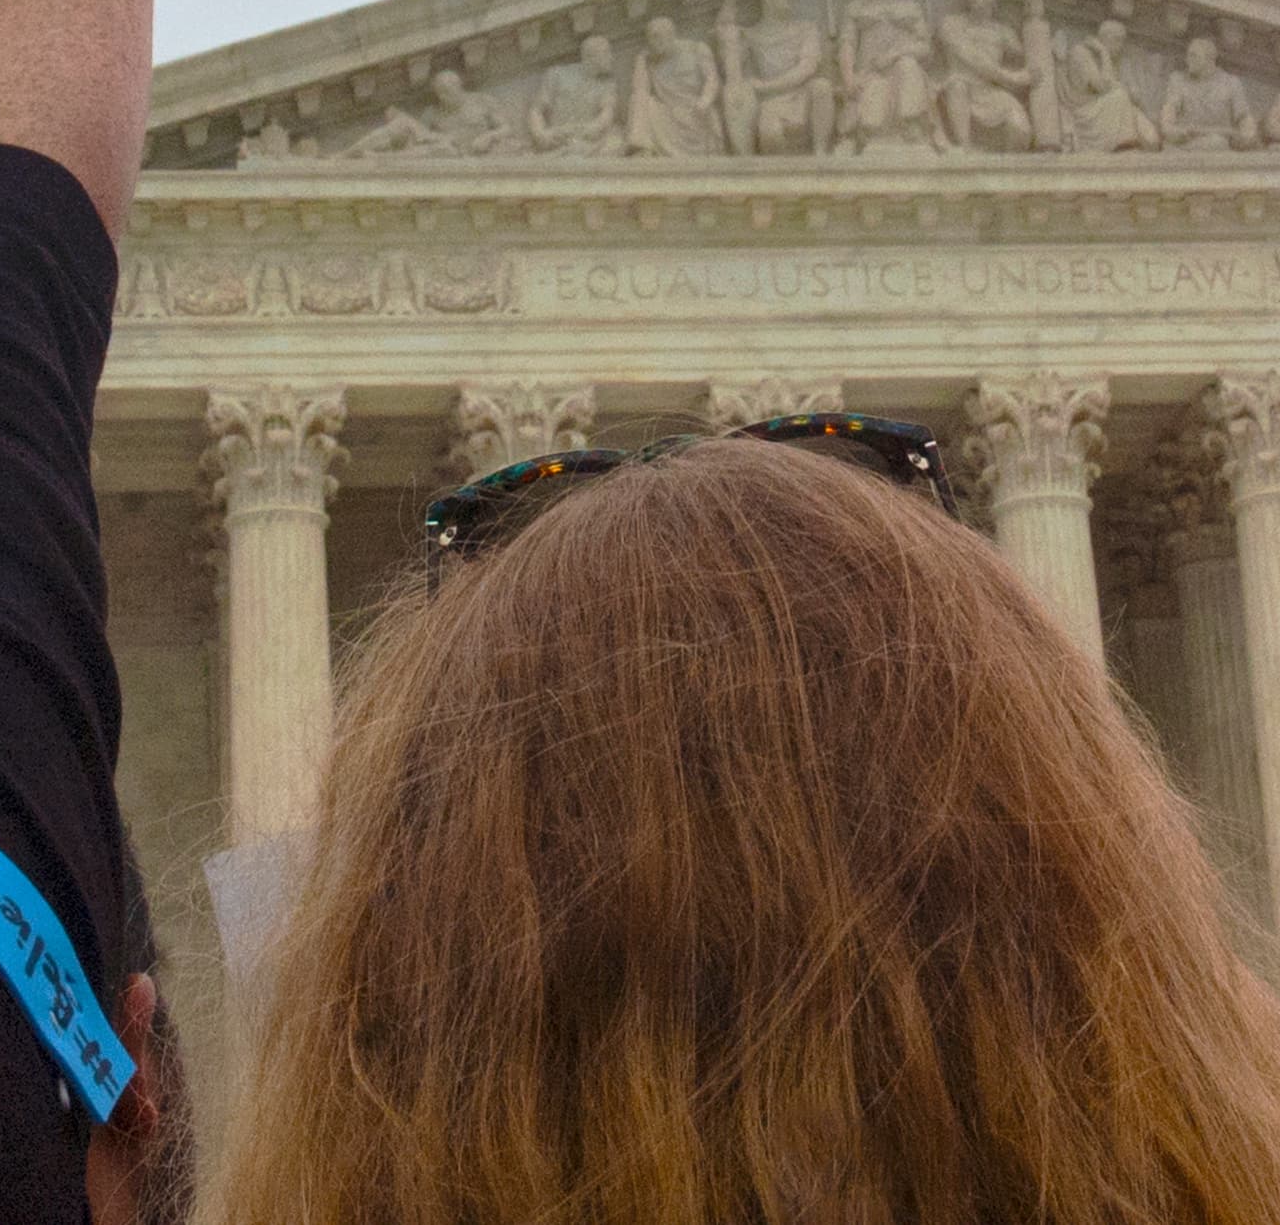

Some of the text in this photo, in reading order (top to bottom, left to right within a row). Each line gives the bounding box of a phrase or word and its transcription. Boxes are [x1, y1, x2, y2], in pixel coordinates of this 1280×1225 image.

[556, 258, 1238, 304] EQUAL JUSTICE UNDER LAW
